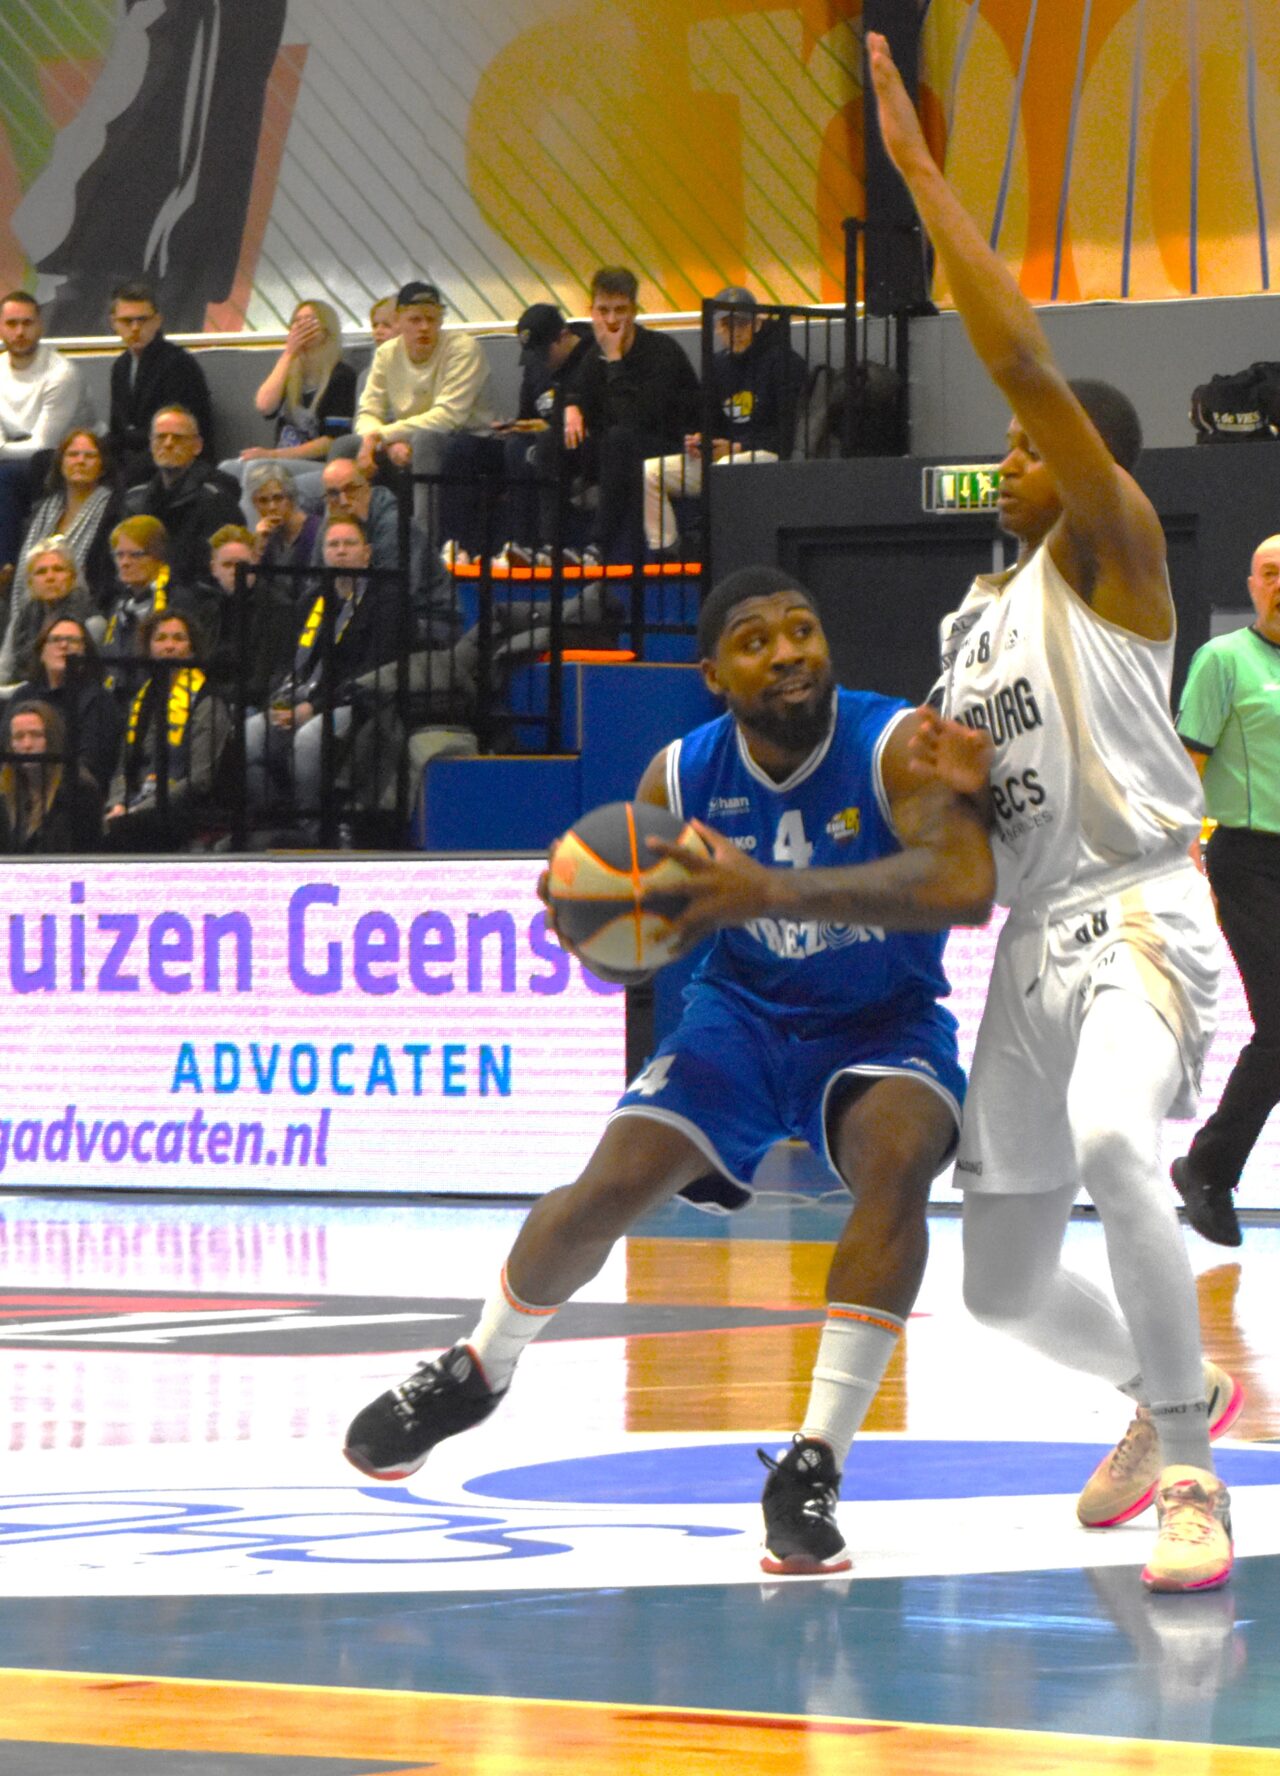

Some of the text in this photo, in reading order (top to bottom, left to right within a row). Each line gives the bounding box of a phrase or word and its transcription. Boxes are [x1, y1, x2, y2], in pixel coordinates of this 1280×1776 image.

[773, 809, 814, 869] 4
[9, 881, 626, 997] uizen Geens
[171, 1042, 513, 1097] ADVOCATEN
[626, 1053, 679, 1096] 4
